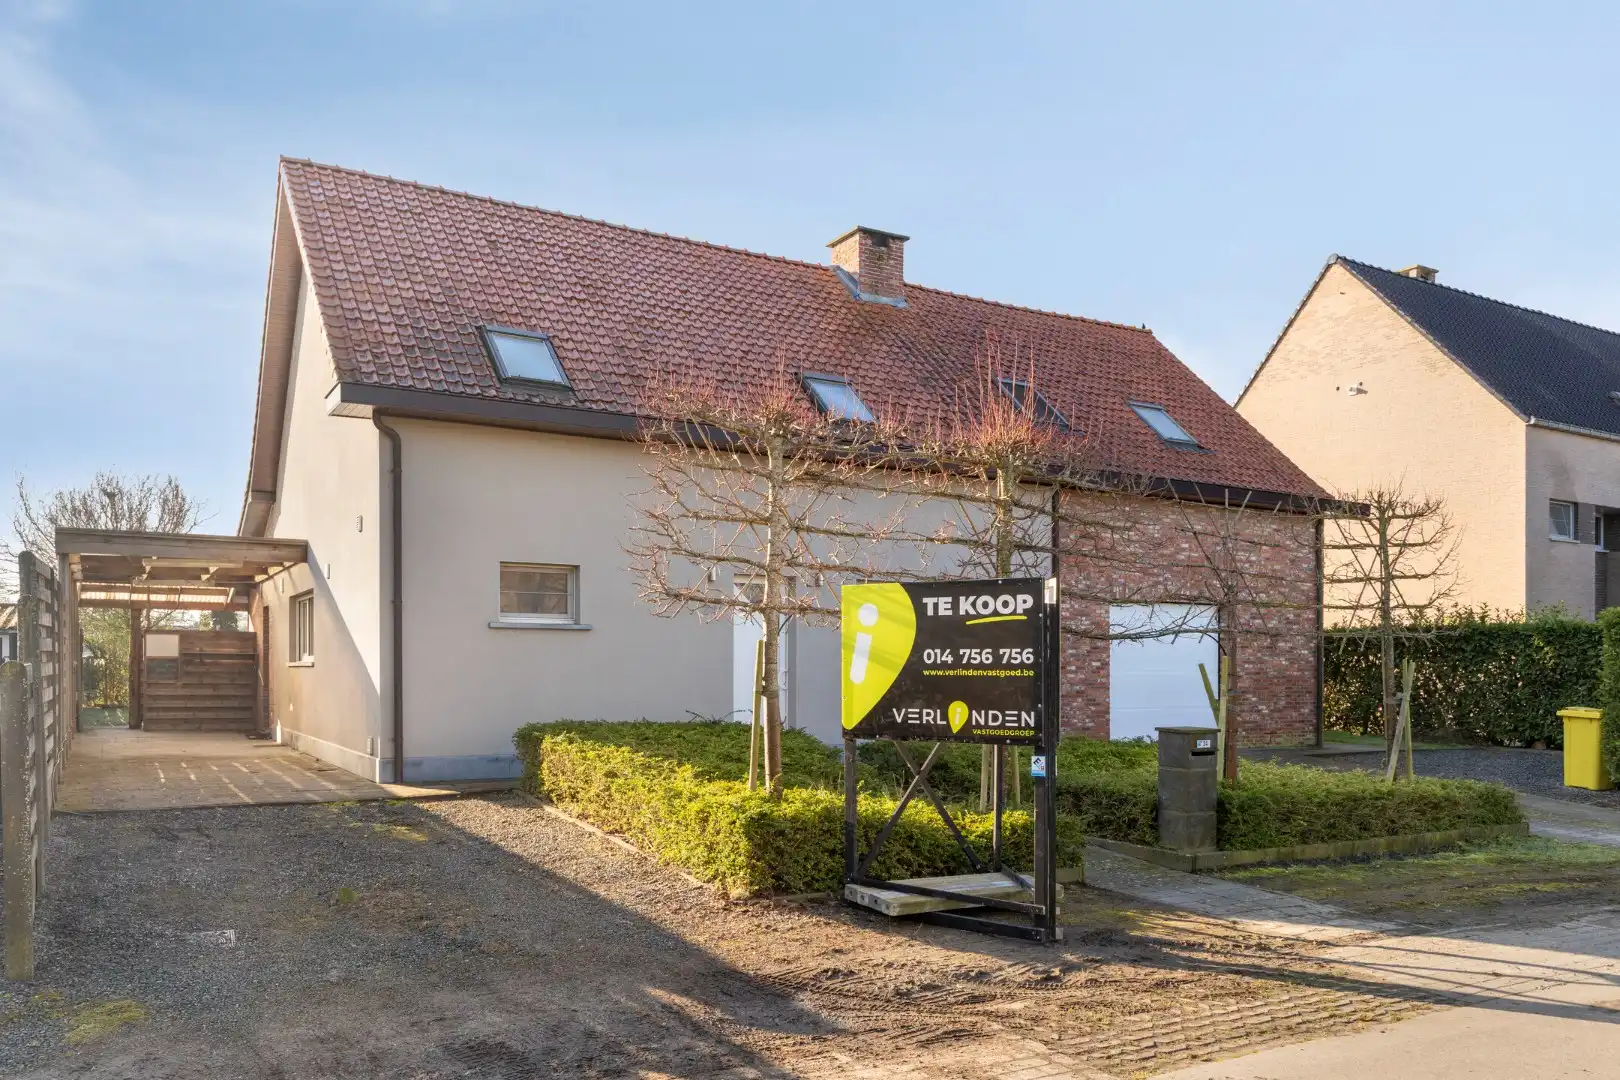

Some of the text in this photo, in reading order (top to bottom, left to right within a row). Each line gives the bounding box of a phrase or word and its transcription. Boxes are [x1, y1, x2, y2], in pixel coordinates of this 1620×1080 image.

[923, 594, 1034, 616] TE KOOP
[923, 648, 1034, 664] 014 756 756
[923, 668, 1034, 678] www.verlindenvastgoed.be
[972, 728, 1035, 737] VASTGOEDGROEP
